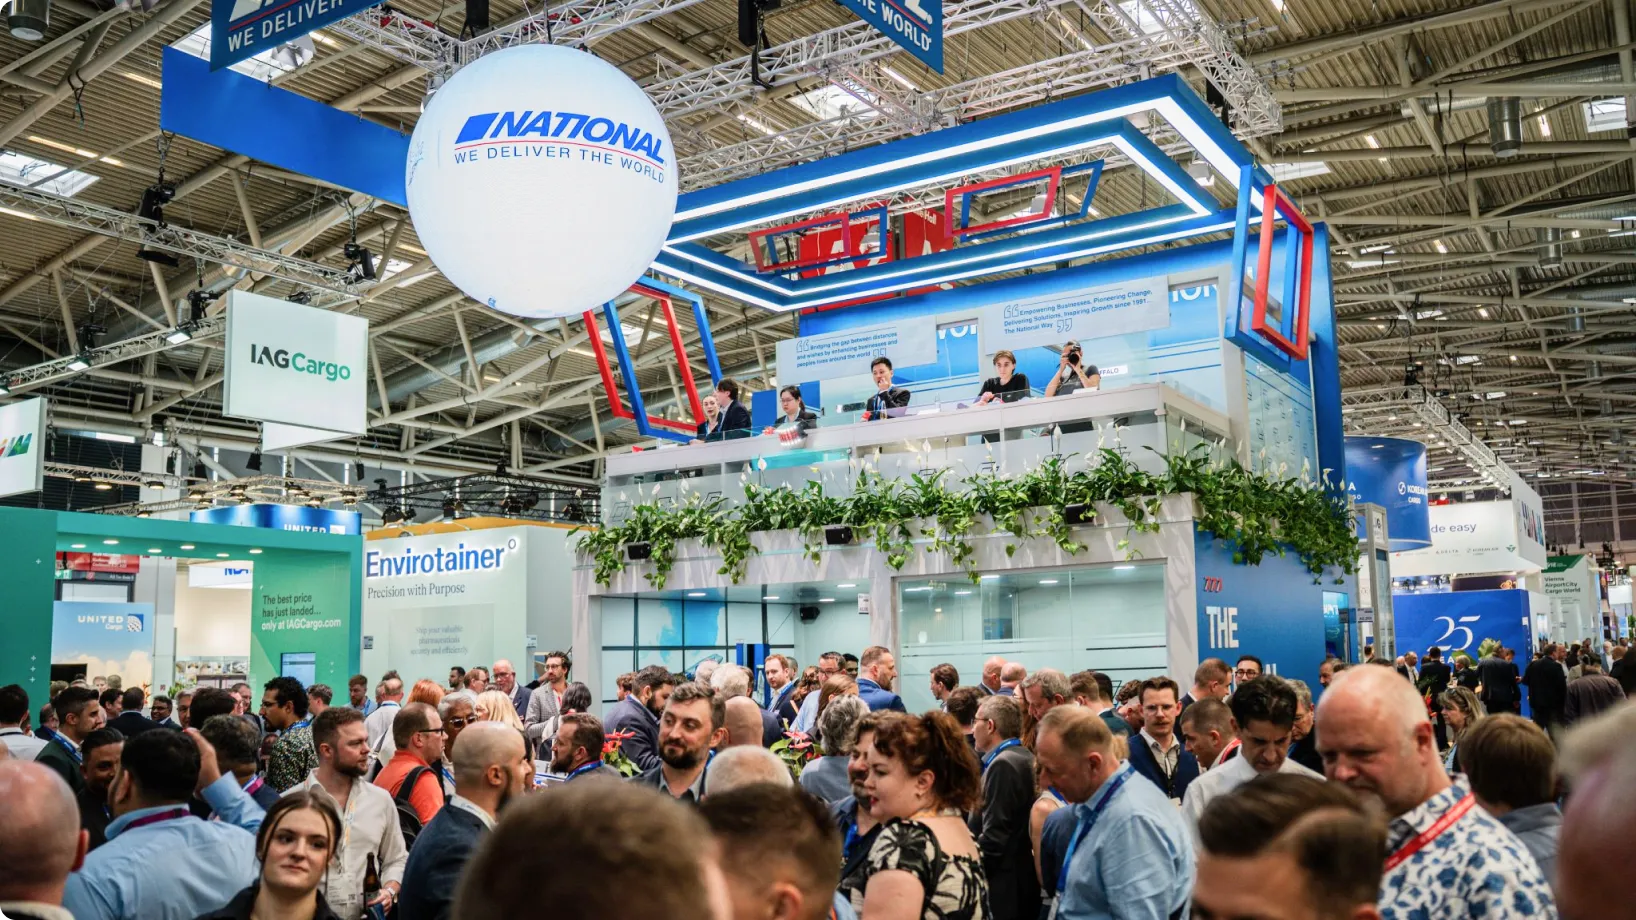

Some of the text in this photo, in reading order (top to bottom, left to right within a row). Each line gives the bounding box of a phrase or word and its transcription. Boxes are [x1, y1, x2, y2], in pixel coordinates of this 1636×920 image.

[882, 3, 932, 51] WORLD
[228, 27, 254, 52] WE
[490, 111, 664, 164] NATIONAL
[455, 146, 664, 183] WE DELIVER THE WORLD
[1020, 306, 1055, 316] Empowering
[1094, 295, 1125, 304] Pioneering
[1004, 318, 1032, 326] Delivering
[1064, 308, 1089, 316] Inspiring
[1092, 304, 1113, 312] Growth
[1016, 324, 1039, 332] National
[810, 342, 830, 350] Bridging
[832, 346, 857, 354] enhancing
[858, 342, 886, 350] businesses
[251, 344, 350, 381] IAGCargo
[1450, 524, 1476, 533] easy
[263, 594, 312, 605] The best price
[368, 583, 465, 598] Precision with Purpose
[78, 615, 123, 623] UNITED
[262, 608, 274, 617] has
[275, 608, 288, 618] just
[262, 621, 276, 632] only
[278, 621, 285, 629] at
[1206, 606, 1239, 648] THE
[1427, 614, 1480, 652] 25
